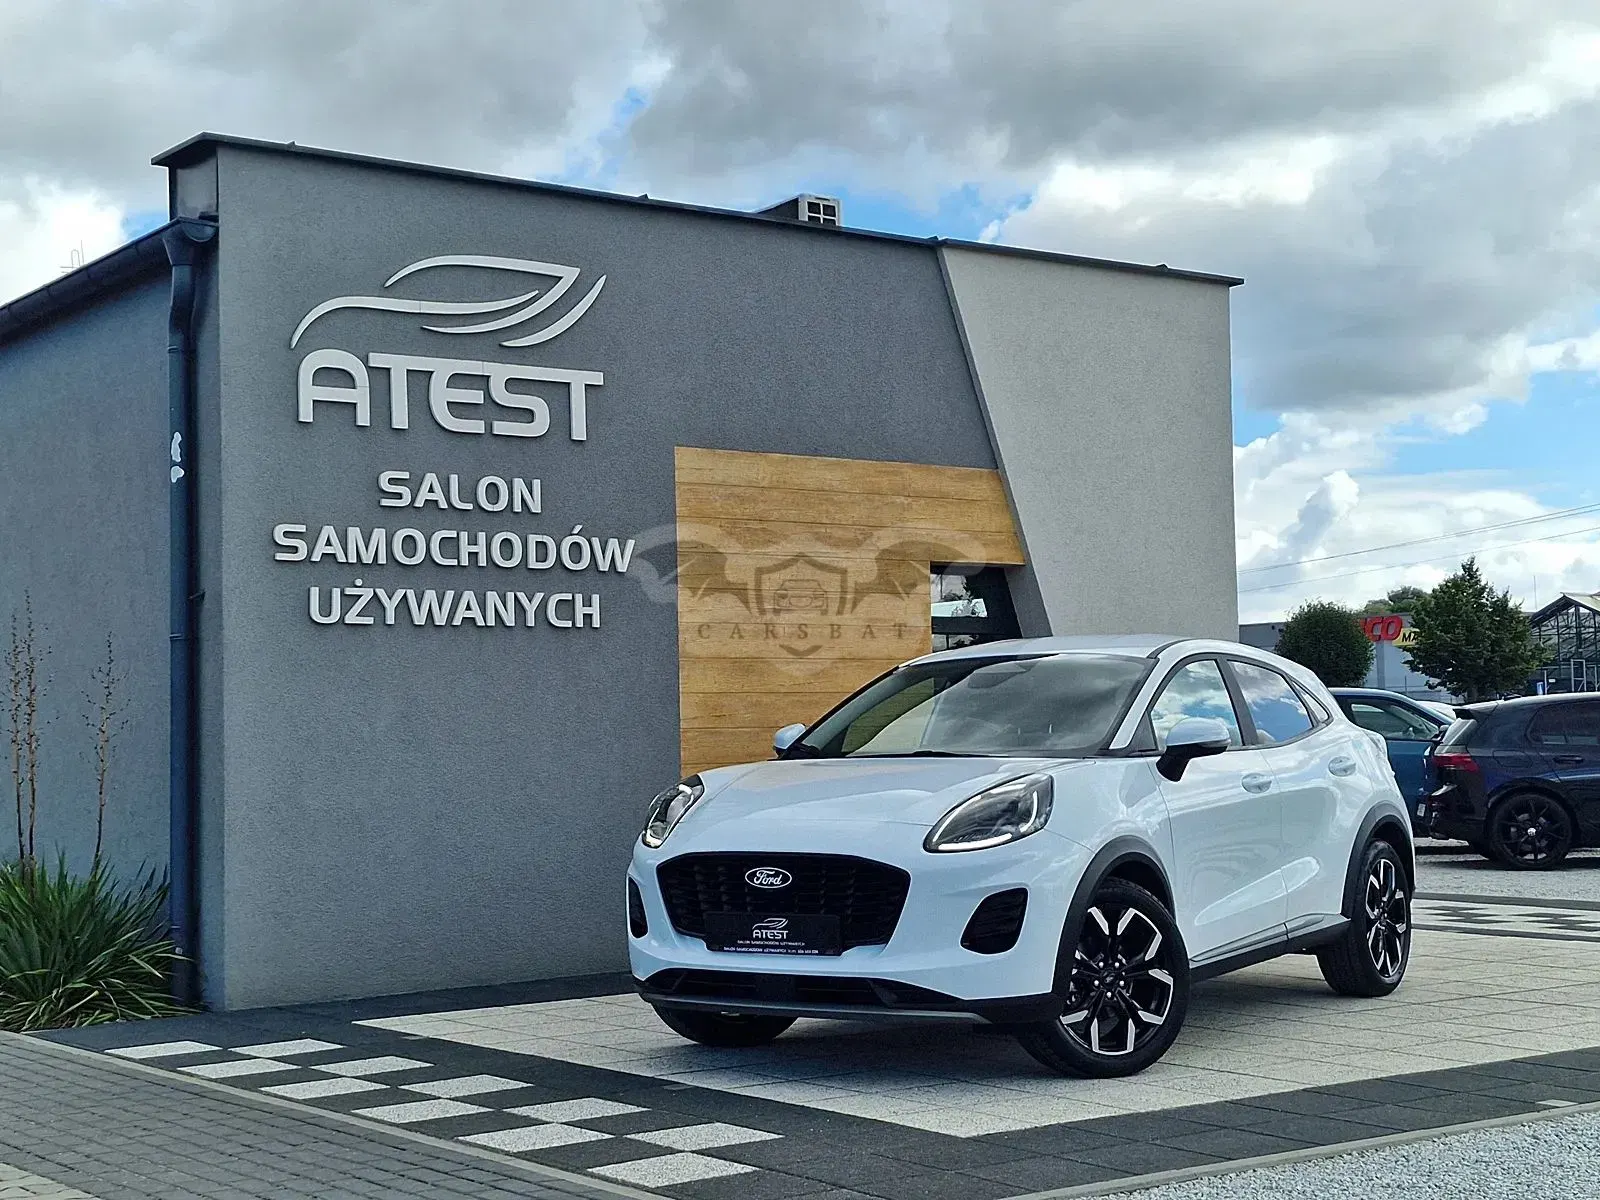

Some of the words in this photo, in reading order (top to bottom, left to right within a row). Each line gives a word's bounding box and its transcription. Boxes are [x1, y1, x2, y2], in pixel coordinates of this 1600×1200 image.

[297, 348, 604, 442] ATEST
[378, 470, 542, 514] SALON
[272, 523, 636, 574] SAMOCHODÓW
[308, 579, 602, 629] UŻYWANYCH
[1359, 616, 1402, 641] CO
[754, 870, 782, 885] Ford
[752, 929, 788, 939] ATEST
